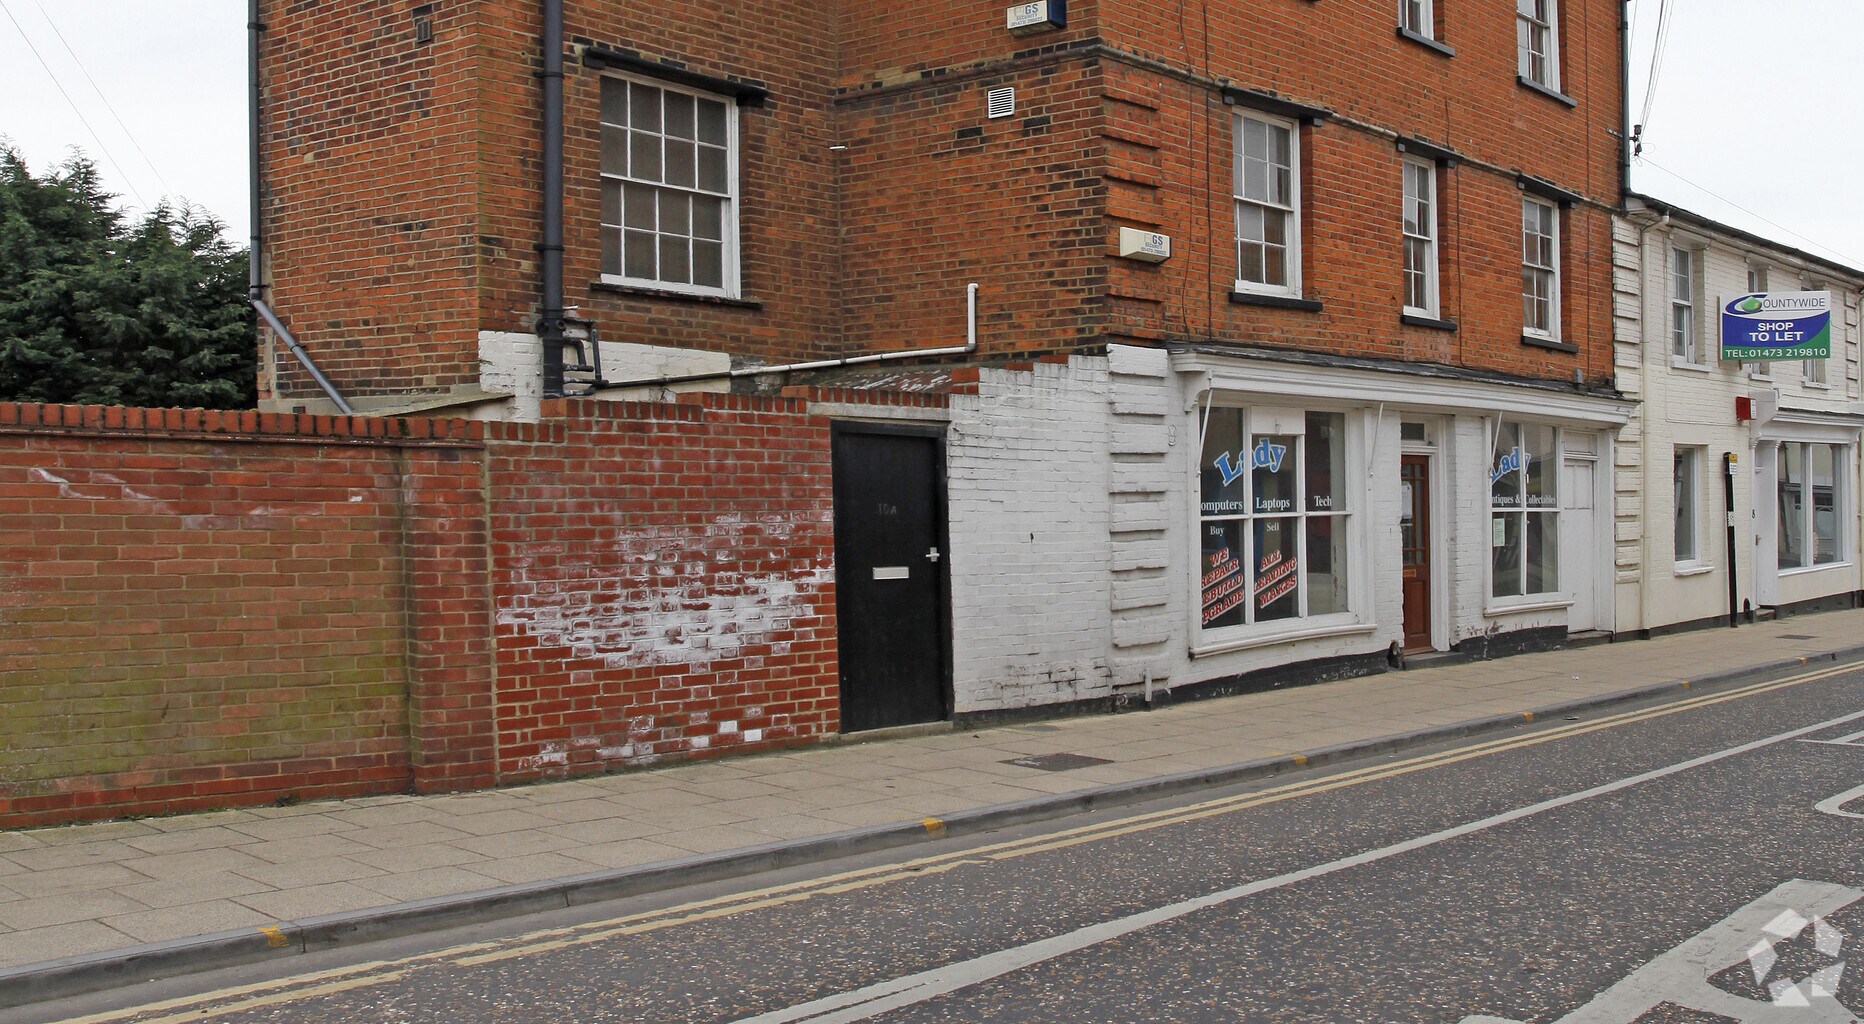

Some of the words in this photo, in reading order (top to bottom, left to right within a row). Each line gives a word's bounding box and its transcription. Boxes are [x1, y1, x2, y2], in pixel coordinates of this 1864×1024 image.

[1025, 4, 1039, 15] GS
[1152, 234, 1163, 246] GS
[1757, 322, 1794, 331] SHOP
[1749, 332, 1770, 342] TO
[1775, 331, 1804, 342] LET
[1785, 347, 1827, 357] 219810
[1201, 499, 1244, 514] omputers
[1255, 497, 1291, 512] Laptops
[1313, 495, 1332, 507] Tech
[1492, 493, 1514, 507] ntiques
[1210, 525, 1225, 537] Buy
[1266, 522, 1281, 532] Sell
[1209, 547, 1229, 568] WE
[1260, 548, 1282, 573] ALL
[1202, 573, 1244, 608] EBUILD
[1259, 574, 1298, 609] MAKES
[1202, 589, 1245, 625] PGRADE
